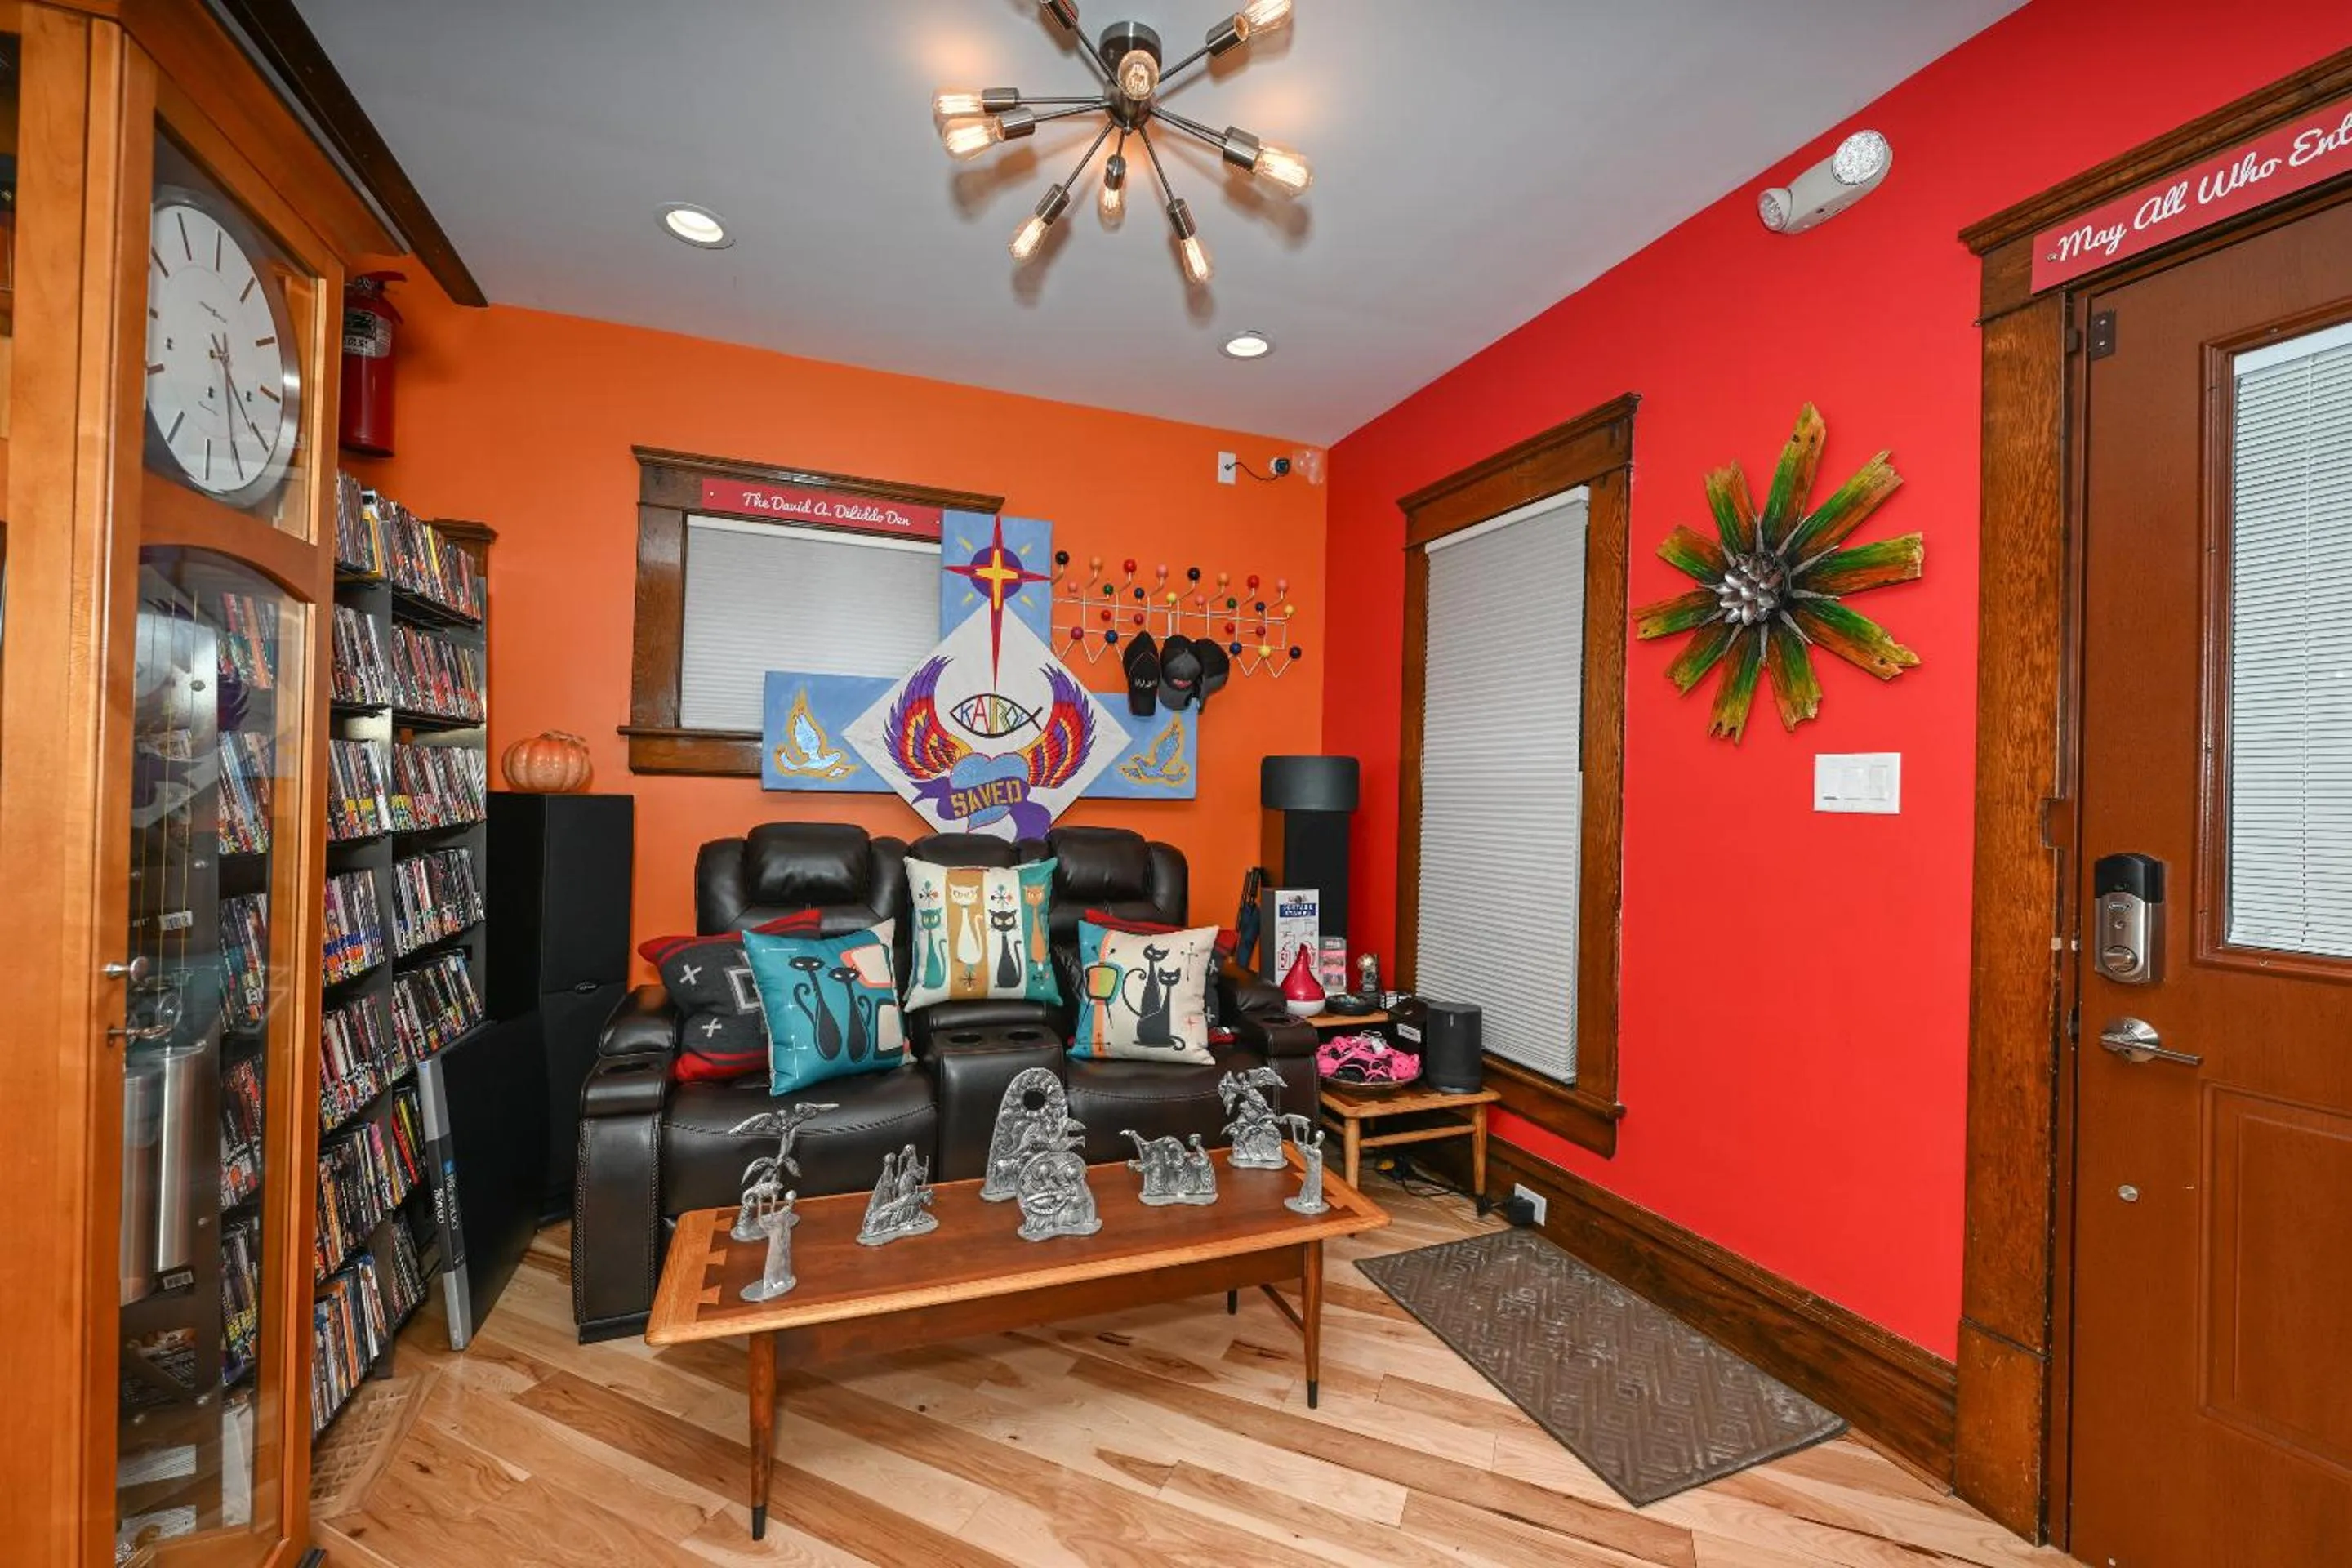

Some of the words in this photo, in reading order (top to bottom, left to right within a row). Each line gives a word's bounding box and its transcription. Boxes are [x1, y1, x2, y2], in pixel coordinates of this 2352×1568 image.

[2057, 221, 2127, 261] May
[2133, 181, 2188, 230] All
[2197, 151, 2283, 205] Who
[742, 492, 770, 508] The
[771, 496, 812, 514] David
[814, 501, 832, 516] A.
[885, 510, 911, 526] Den
[950, 780, 1021, 817] SAVED
